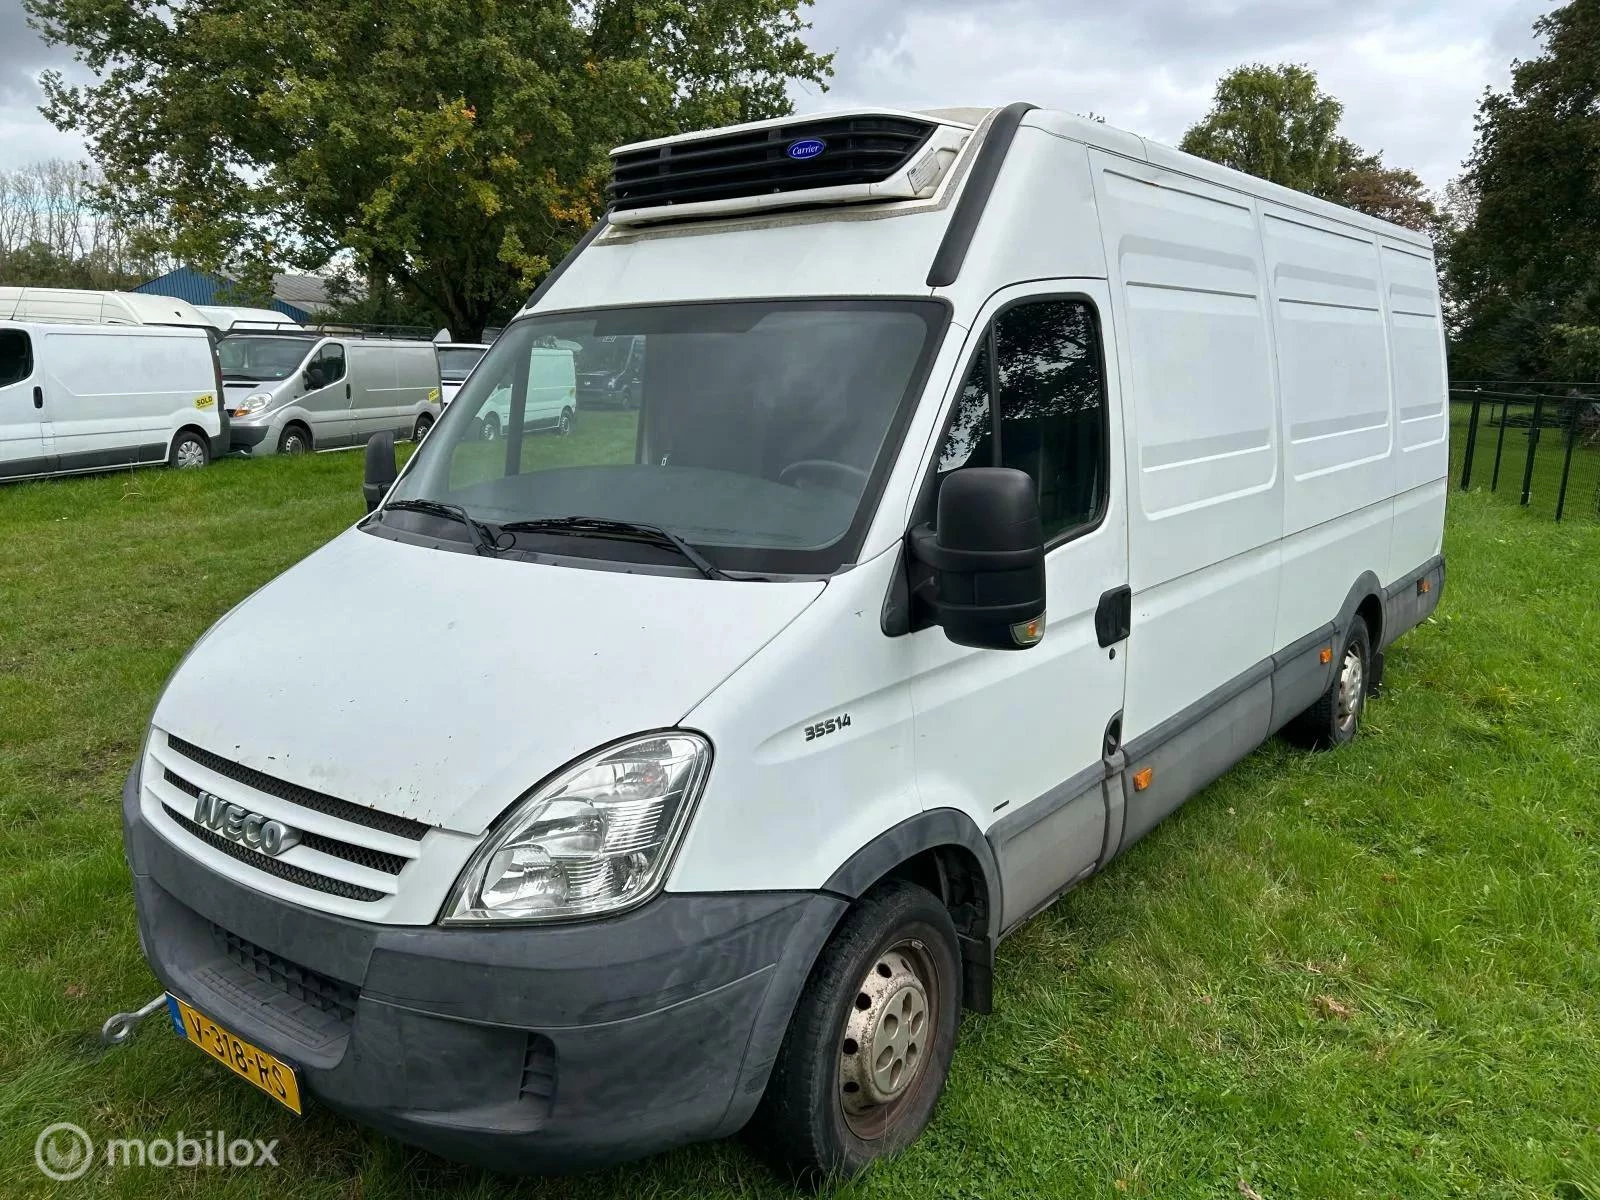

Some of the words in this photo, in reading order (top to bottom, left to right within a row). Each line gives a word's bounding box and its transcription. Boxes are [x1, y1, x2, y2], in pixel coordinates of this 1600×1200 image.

[792, 145, 819, 156] Carrier
[196, 396, 213, 406] SOLD
[804, 713, 851, 742] 35S14
[193, 790, 298, 856] IVECO
[187, 1010, 287, 1099] V-318-RS
